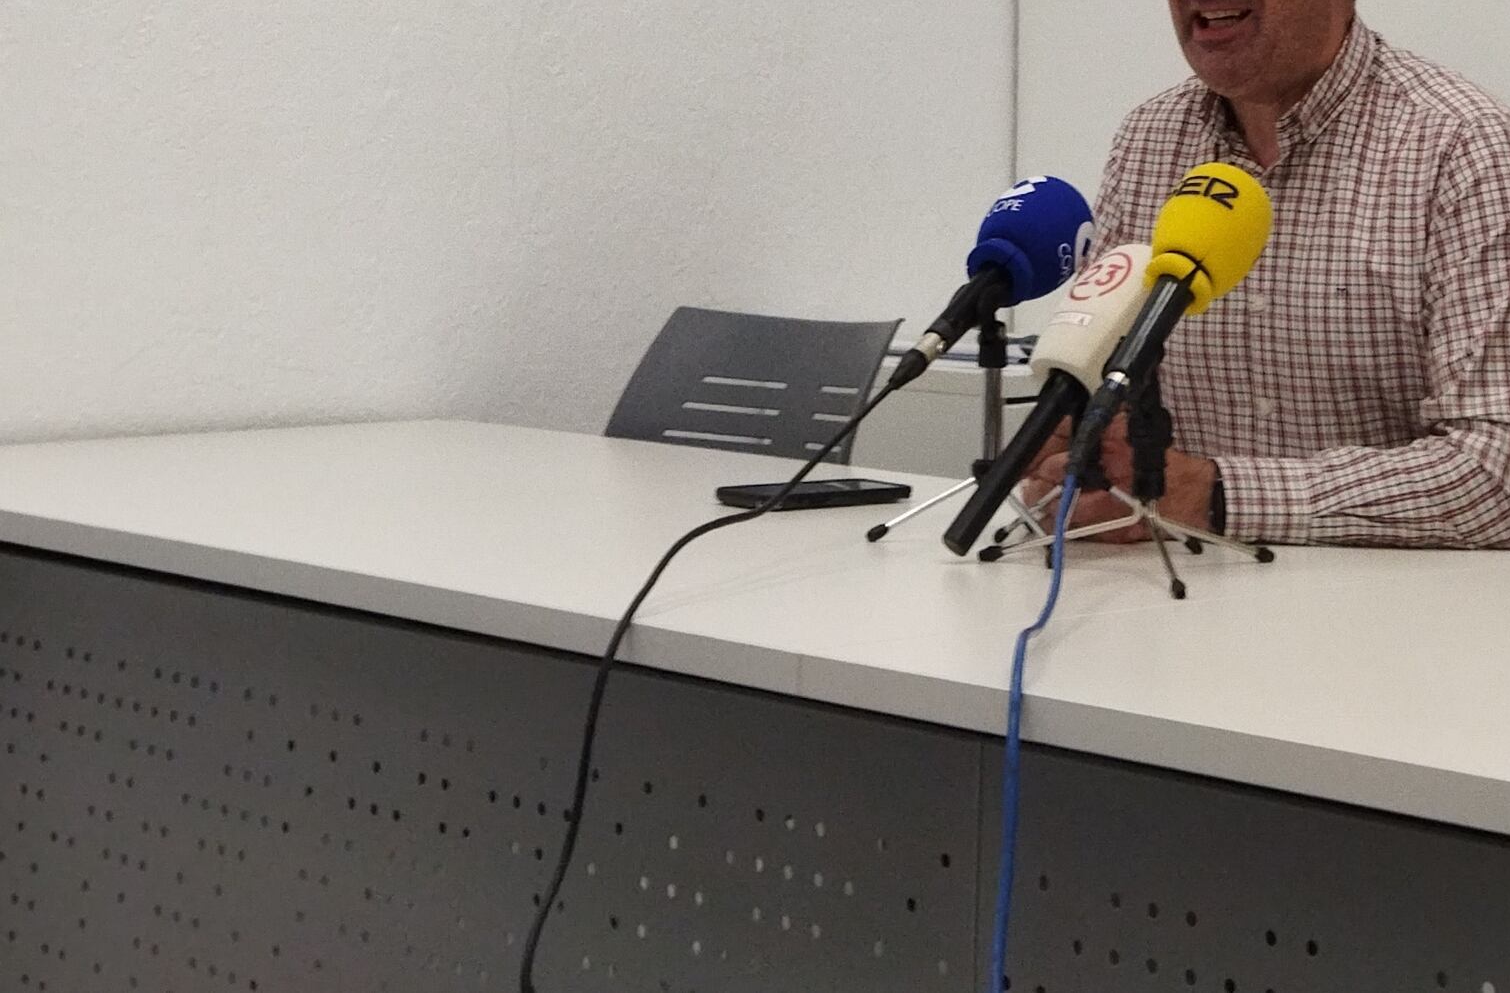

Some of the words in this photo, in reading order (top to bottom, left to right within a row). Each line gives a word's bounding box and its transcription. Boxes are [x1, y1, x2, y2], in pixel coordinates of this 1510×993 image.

[1174, 175, 1239, 210] ER
[986, 198, 1025, 218] OPE
[1073, 263, 1125, 287] 23
